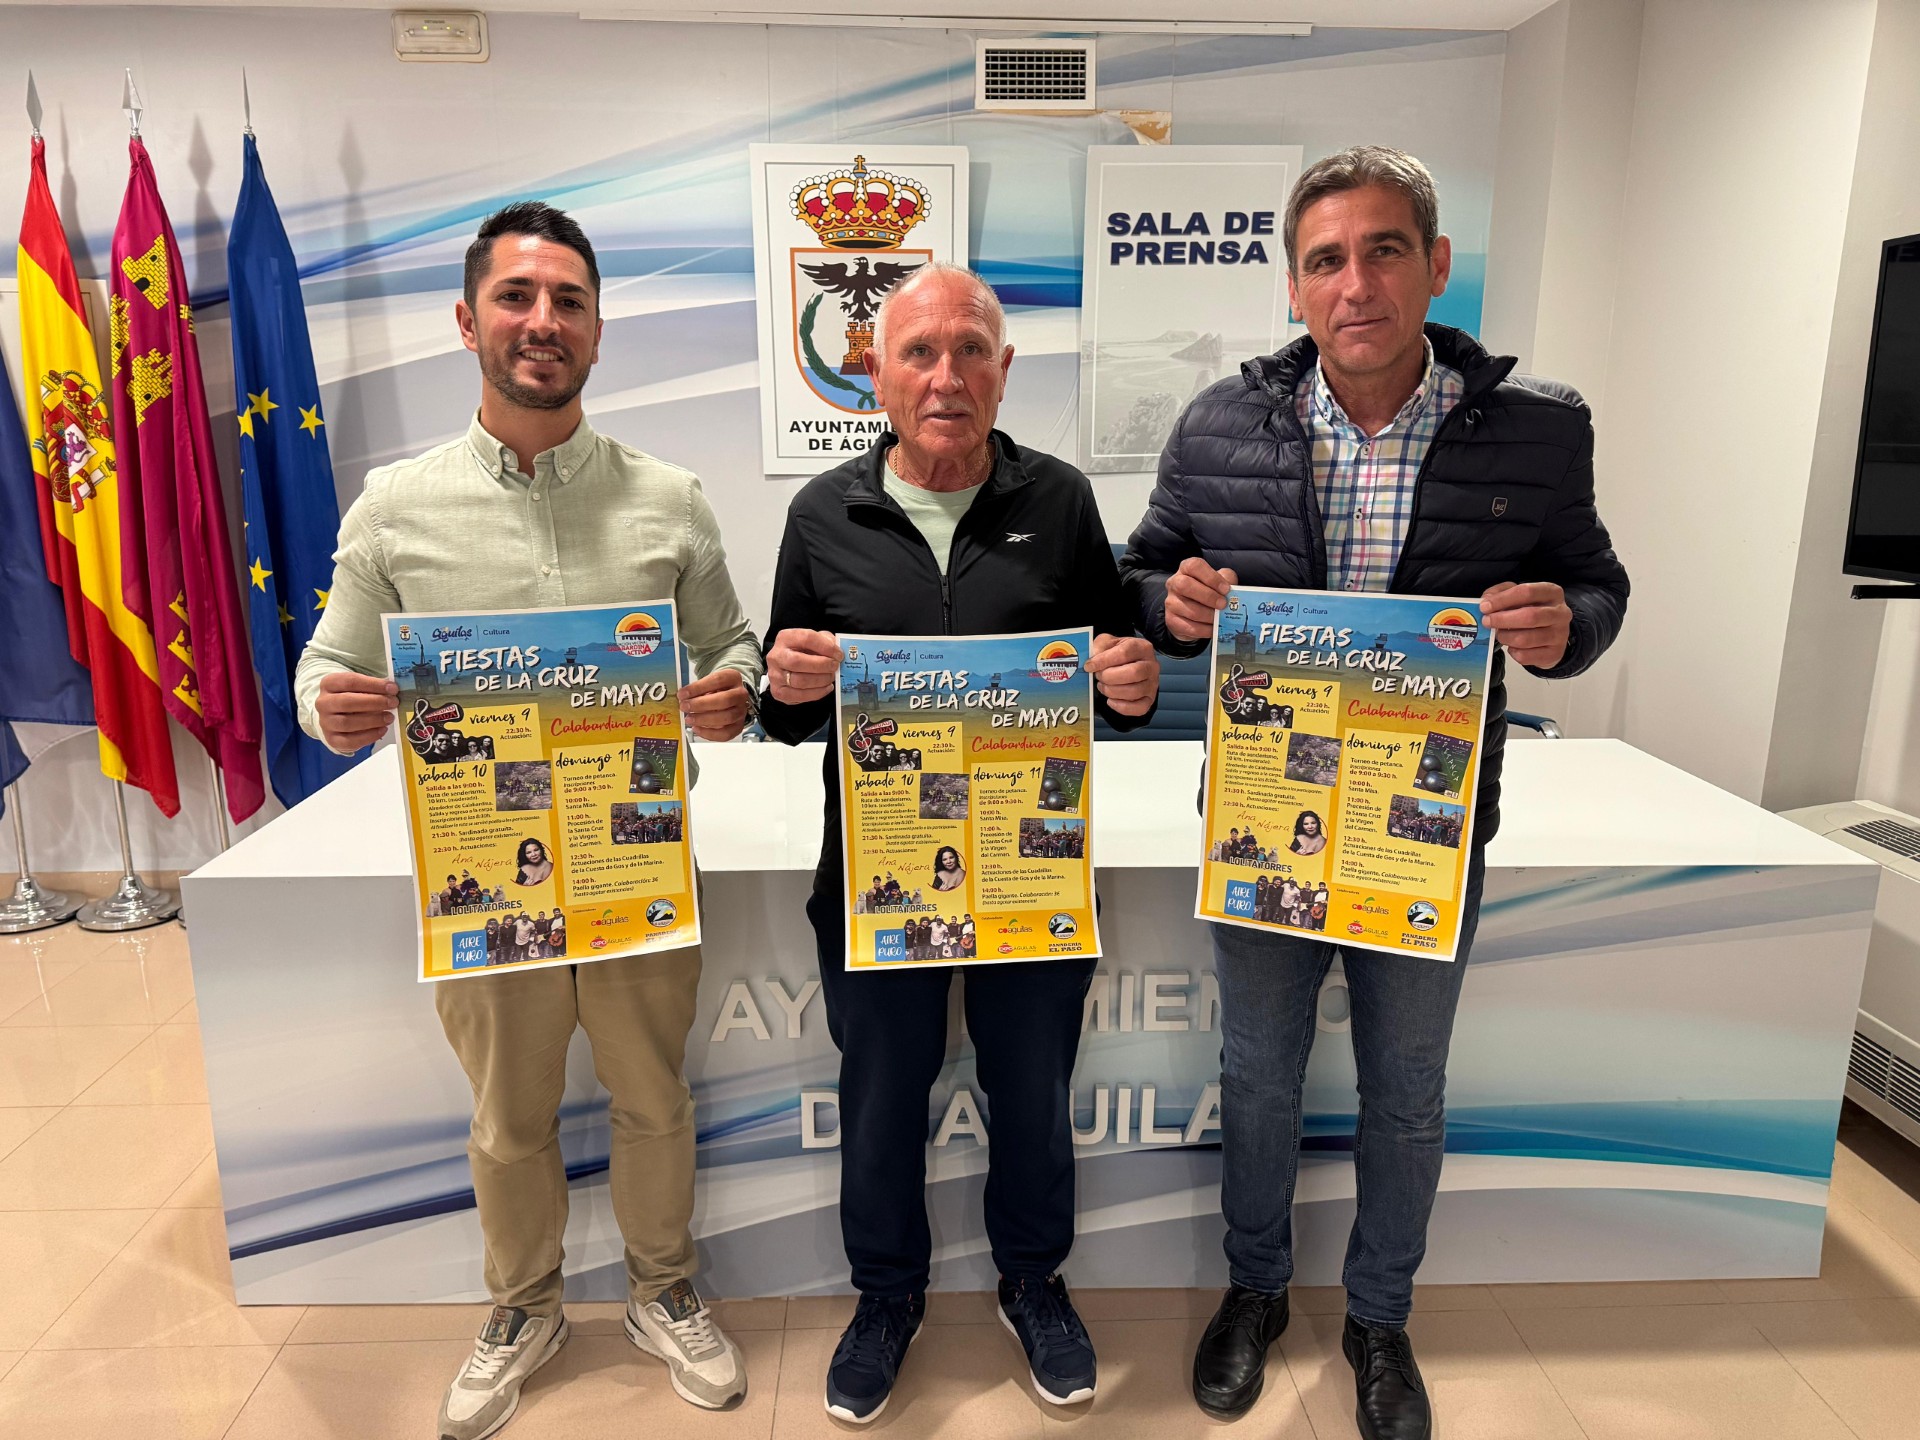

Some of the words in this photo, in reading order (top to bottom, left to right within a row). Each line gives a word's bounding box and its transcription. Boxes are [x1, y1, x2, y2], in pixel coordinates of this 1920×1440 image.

[1107, 212, 1211, 236] SALA
[1223, 212, 1275, 235] DE
[1110, 241, 1269, 265] PRENSA
[809, 439, 833, 450] DE
[1259, 623, 1353, 649] FIESTAS
[439, 645, 541, 673] FIESTAS
[1287, 650, 1311, 665] DE
[1315, 650, 1340, 669] LA
[1344, 649, 1407, 672] CRUZ
[475, 674, 501, 692] DE
[506, 672, 532, 691] LA
[538, 664, 600, 688] CRUZ
[880, 669, 969, 692] FIESTAS
[1371, 676, 1397, 693] DE
[1401, 674, 1471, 700] MAYO
[570, 691, 596, 708] DE
[600, 682, 667, 707] MAYO
[910, 695, 932, 710] DE
[936, 693, 960, 710] LA
[964, 689, 1020, 710] CRUZ
[1276, 685, 1318, 699] viernes
[1323, 685, 1333, 698] 9
[470, 713, 515, 725] viernes
[521, 708, 530, 721] 9
[991, 713, 1014, 728] DE
[1018, 706, 1080, 729] MAYO
[1347, 700, 1431, 721] Calabardina
[1435, 709, 1470, 725] 2025
[551, 715, 633, 737] Calabardina
[639, 713, 672, 727] 2025
[902, 730, 942, 740] viernes
[947, 725, 956, 737] 9
[972, 736, 1046, 753] Calabardina
[1051, 735, 1081, 748] 2025
[1222, 727, 1263, 744] sábado
[1270, 731, 1284, 744] 10
[1346, 733, 1402, 759] domingo
[1409, 741, 1422, 754] 11
[556, 752, 612, 771] domingo
[618, 749, 630, 761] 11
[418, 764, 466, 785] sábado
[472, 764, 487, 778] 10
[854, 772, 895, 791] sábado
[901, 773, 914, 786] 10
[974, 767, 1024, 786] domingo
[1030, 766, 1041, 779] 11
[1247, 790, 1273, 798] Sardinada
[1246, 803, 1280, 812] Actuaciones:
[1237, 811, 1256, 821] Ana
[1256, 820, 1290, 832] Nájera
[458, 828, 488, 836] Sardinada
[460, 843, 497, 851] Actuaciones:
[452, 853, 474, 864] Ana
[475, 858, 513, 871] Nájera
[878, 856, 897, 866] Ana
[897, 862, 930, 875] Nájera
[1230, 856, 1259, 869] LOLITA
[1260, 861, 1293, 873] TORRES
[1231, 886, 1252, 898] AIRE
[451, 903, 484, 915] LOLITA
[486, 900, 522, 913] TORRES
[875, 905, 902, 914] LOLITA
[904, 903, 938, 913] TORRES
[1227, 898, 1252, 911] PURO
[457, 936, 483, 949] AIRE
[880, 934, 901, 945] AIRE
[1413, 940, 1437, 949] PASO
[455, 950, 483, 963] PURO
[878, 946, 903, 957] PURO
